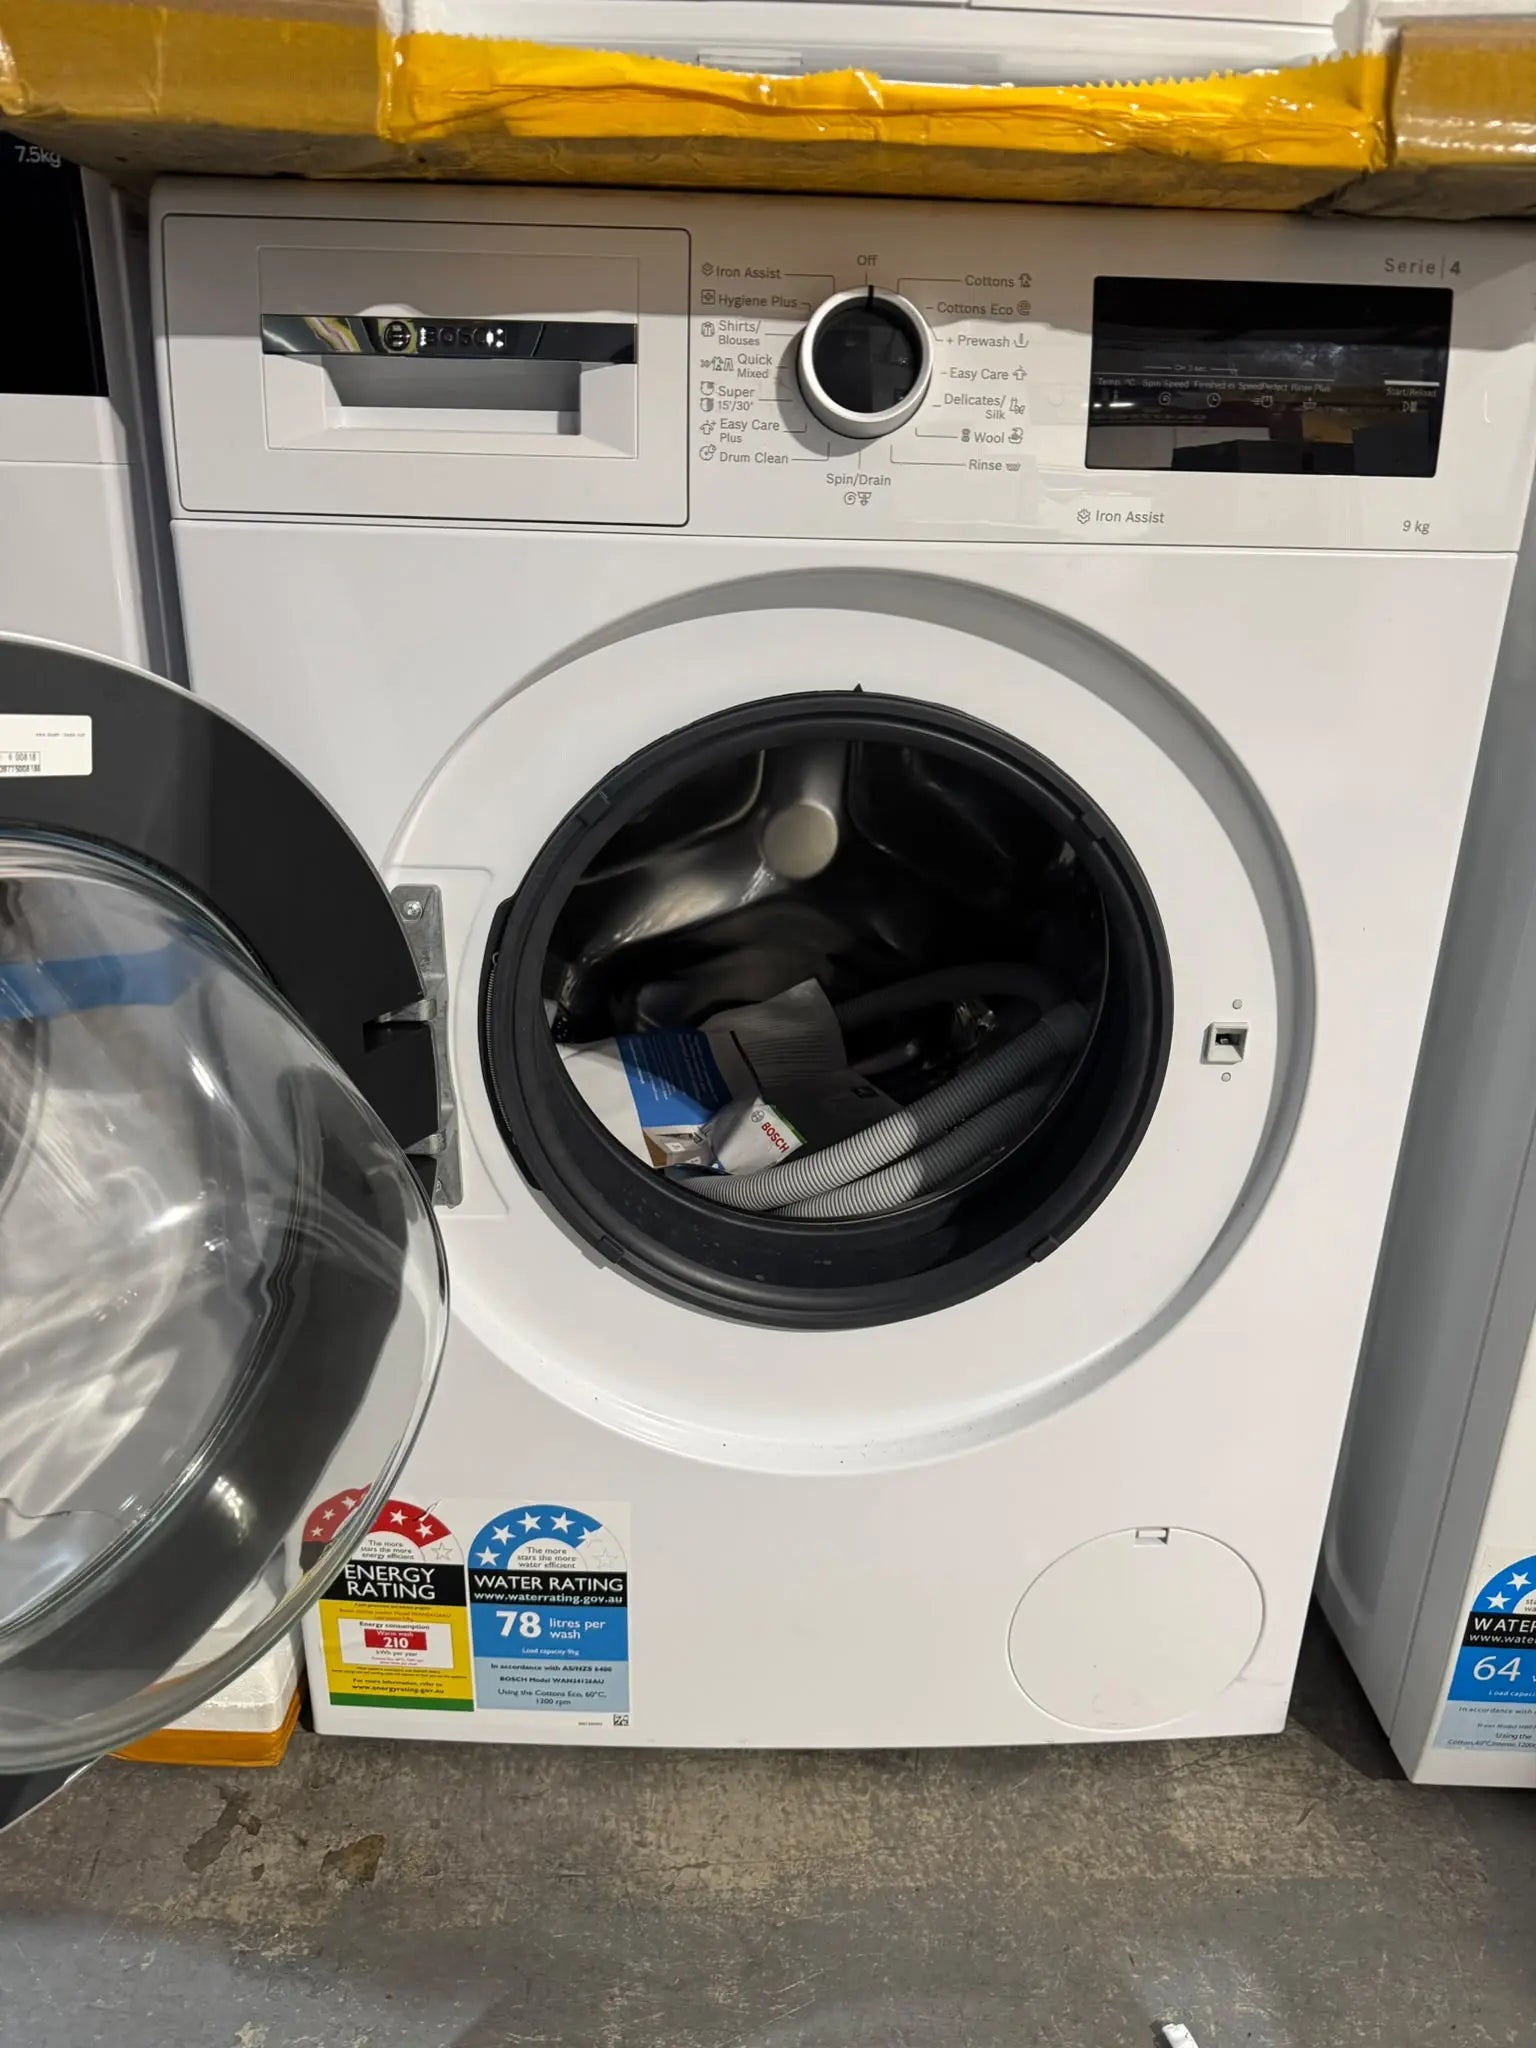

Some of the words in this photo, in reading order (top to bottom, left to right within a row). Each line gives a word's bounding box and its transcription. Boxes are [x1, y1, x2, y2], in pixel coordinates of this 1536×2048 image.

[14, 145, 62, 168] 7.5kg
[856, 253, 879, 267] Off
[1383, 257, 1437, 276] Serie
[1448, 260, 1461, 275] 4
[716, 265, 741, 277] Iron
[744, 267, 783, 279] Assist
[964, 274, 1014, 288] Cottons
[718, 294, 768, 309] Hygiene
[771, 296, 799, 308] Plus
[937, 302, 986, 315] Cottons
[990, 303, 1014, 316] Eco
[719, 320, 762, 334] Shirts/
[719, 335, 761, 346] Blouses
[957, 334, 1011, 348] Prewash
[736, 352, 773, 366] Quick
[736, 368, 769, 379] Mixed
[949, 367, 978, 382] Easy
[981, 368, 1010, 381] Care
[718, 385, 755, 399] Super
[944, 393, 1007, 408] Delicates/
[985, 409, 1006, 420] Silk
[719, 418, 749, 432] Easy
[752, 419, 780, 431] Care
[719, 432, 743, 443] Plus
[974, 431, 1005, 444] Wool
[719, 452, 751, 463] Drum
[754, 452, 789, 464] Clean
[968, 459, 1003, 471] Rinse
[825, 473, 892, 487] Spin/Drain
[1096, 510, 1121, 522] Iron
[1125, 511, 1165, 524] Assist
[1402, 520, 1411, 532] 9
[1414, 520, 1431, 535] kg
[761, 1121, 790, 1153] BOSCH
[368, 1539, 382, 1547] The
[361, 1552, 385, 1560] energy
[527, 1546, 543, 1554] The
[544, 1547, 567, 1555] more
[344, 1564, 436, 1583] ENERGY
[473, 1574, 544, 1591] WATER
[549, 1577, 624, 1592] RATING
[346, 1581, 436, 1600] RATING
[473, 1591, 624, 1605] www.waterrating.gov.au
[359, 1621, 384, 1630] Energy
[385, 1623, 430, 1631] consumption
[495, 1610, 543, 1639] 78
[549, 1617, 581, 1628] litres
[584, 1619, 606, 1632] per
[549, 1629, 581, 1640] wash
[1470, 1633, 1536, 1644] www.wate
[382, 1637, 409, 1649] 210
[1472, 1655, 1521, 1682] 64
[352, 1684, 445, 1694] www.energyrating.gov.au
[497, 1688, 520, 1698] Using
[535, 1690, 564, 1698] Cottons
[555, 1699, 572, 1707] rpm
[1495, 1732, 1518, 1740] Using
